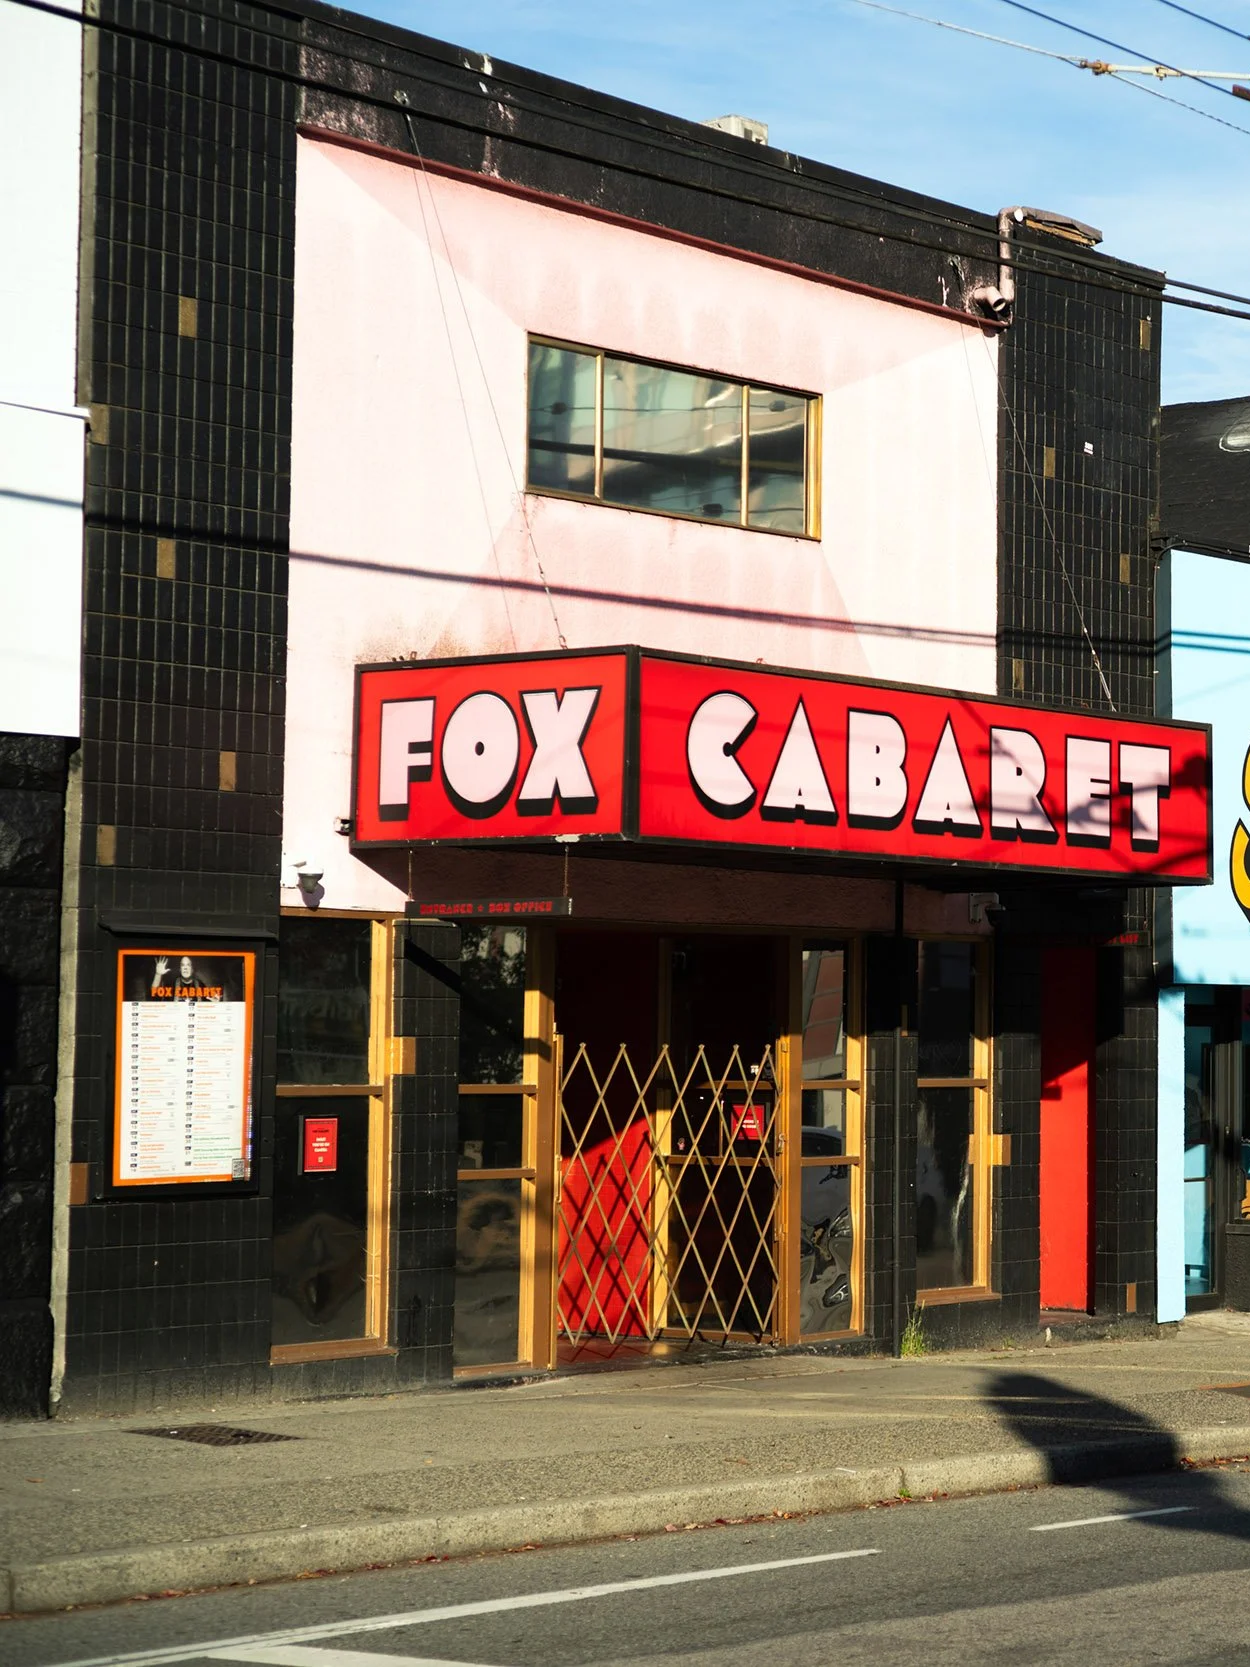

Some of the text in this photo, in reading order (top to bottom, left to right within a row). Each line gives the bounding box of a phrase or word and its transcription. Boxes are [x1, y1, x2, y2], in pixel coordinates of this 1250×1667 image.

[377, 684, 602, 823] FOX
[686, 688, 1173, 853] CABARET
[488, 902, 511, 914] BOX
[513, 901, 553, 912] OFFICE
[151, 986, 222, 998] FOX CABARET
